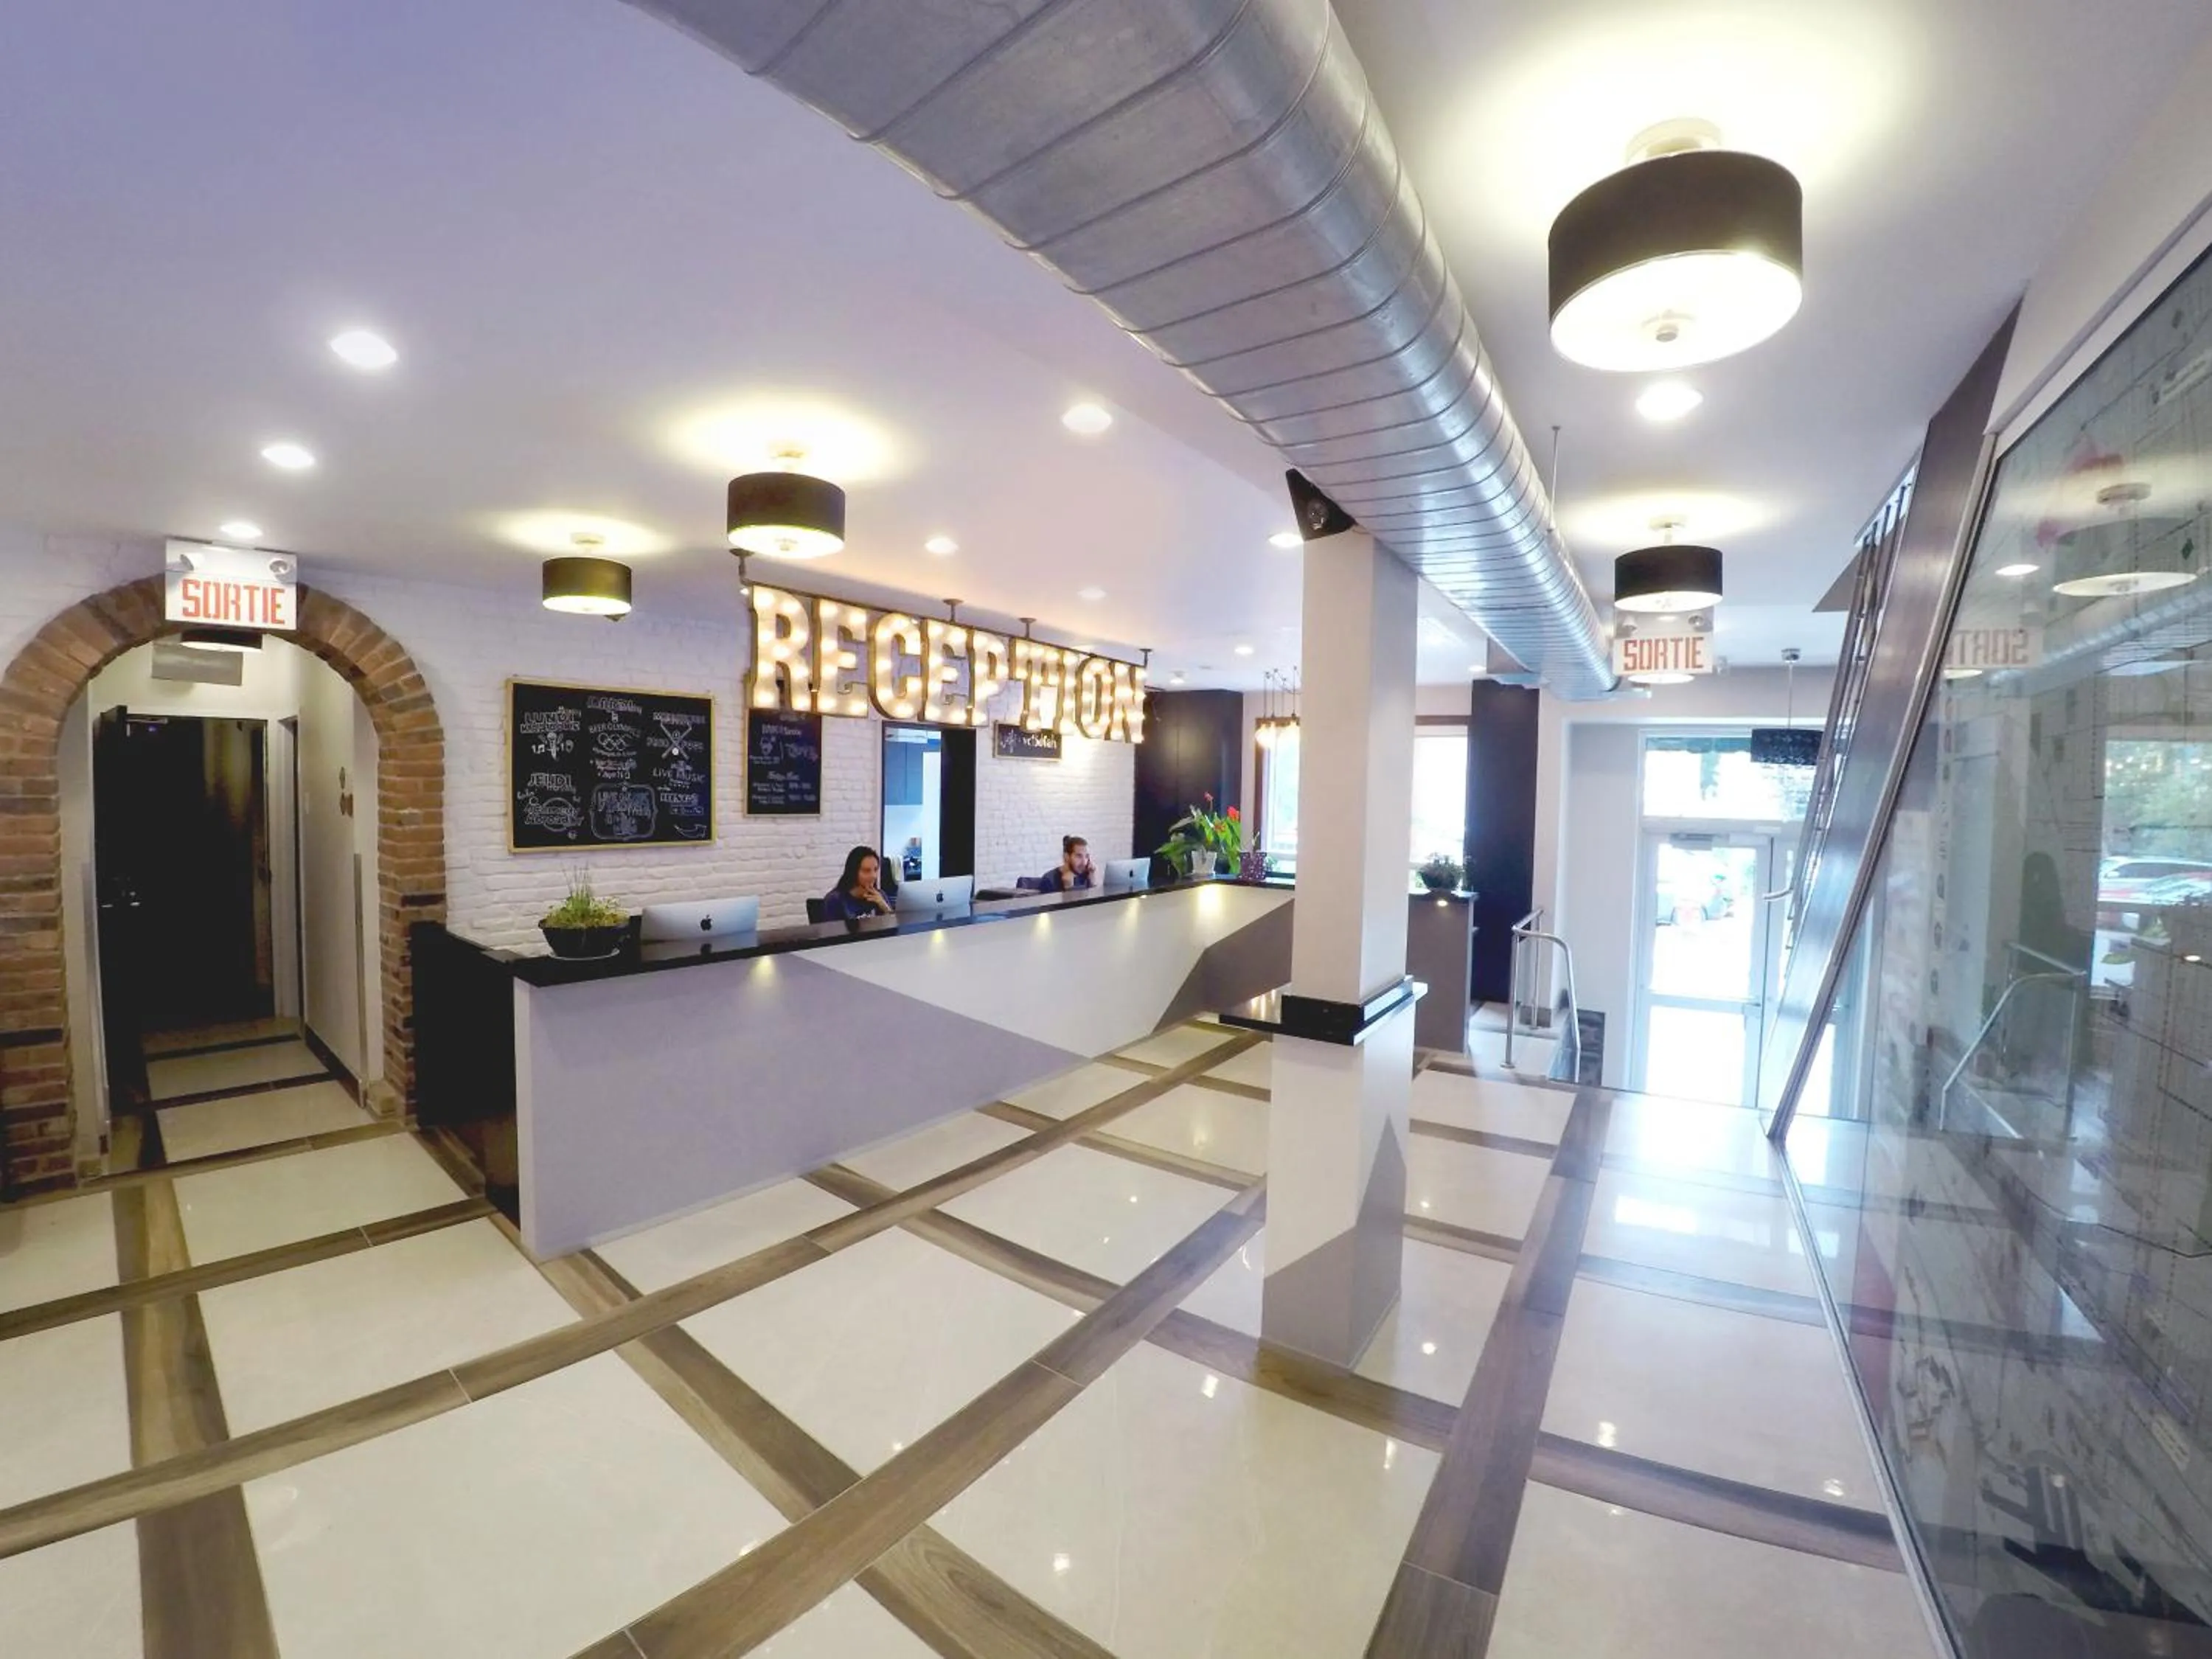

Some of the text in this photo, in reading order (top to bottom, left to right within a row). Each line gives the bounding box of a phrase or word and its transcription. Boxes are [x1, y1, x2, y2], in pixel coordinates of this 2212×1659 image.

[181, 577, 285, 625] SORTIE
[748, 582, 1146, 744] RECEPTION
[1624, 636, 1705, 671] SORTIE
